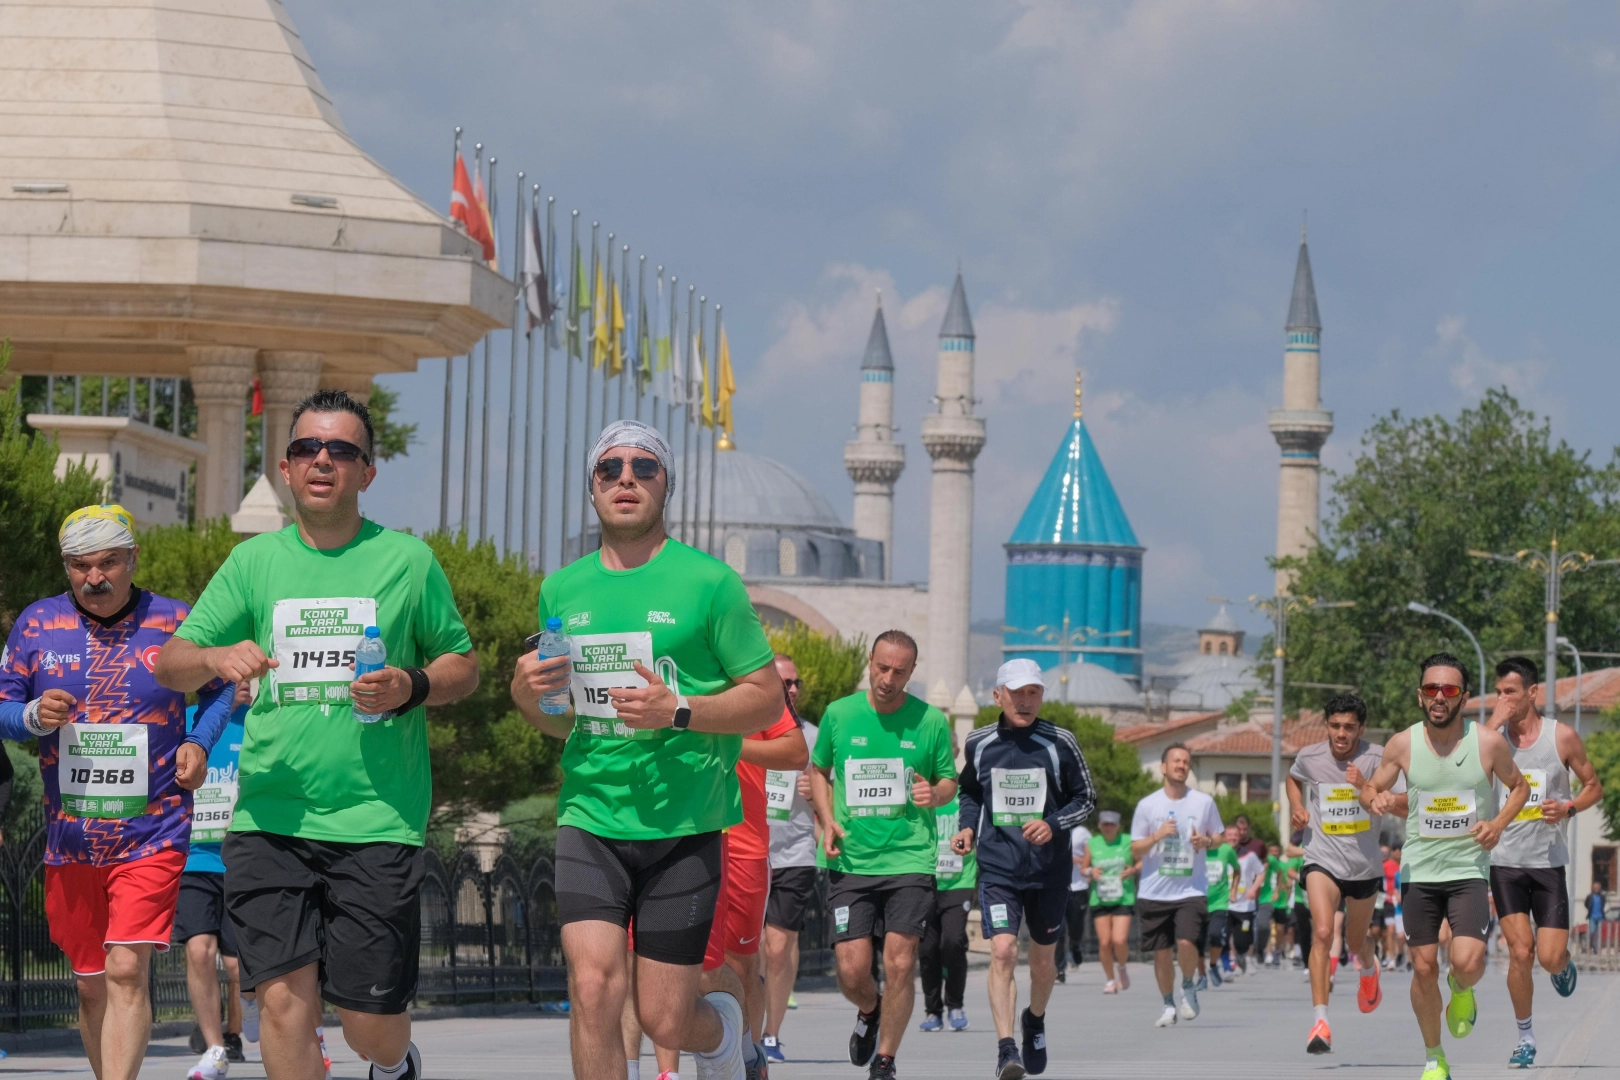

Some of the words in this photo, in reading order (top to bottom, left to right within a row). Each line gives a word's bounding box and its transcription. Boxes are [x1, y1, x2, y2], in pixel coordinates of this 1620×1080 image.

[304, 609, 345, 619] KONYA
[648, 610, 670, 619] SPOR
[310, 618, 338, 626] YARI
[647, 616, 676, 625] KONYA
[290, 626, 359, 636] MARATONU
[585, 645, 624, 655] KONYA
[58, 653, 81, 663] YBS
[293, 650, 356, 669] 11435
[592, 654, 618, 663] YARI
[583, 686, 637, 705] 115
[83, 733, 120, 741] KONYA
[88, 740, 114, 748] YARI
[72, 747, 132, 755] MARATONU
[70, 768, 134, 784] 10368
[858, 787, 892, 798] 11031
[1005, 796, 1035, 806] 10311
[1328, 806, 1360, 816] 42151
[1425, 817, 1469, 829] 42264
